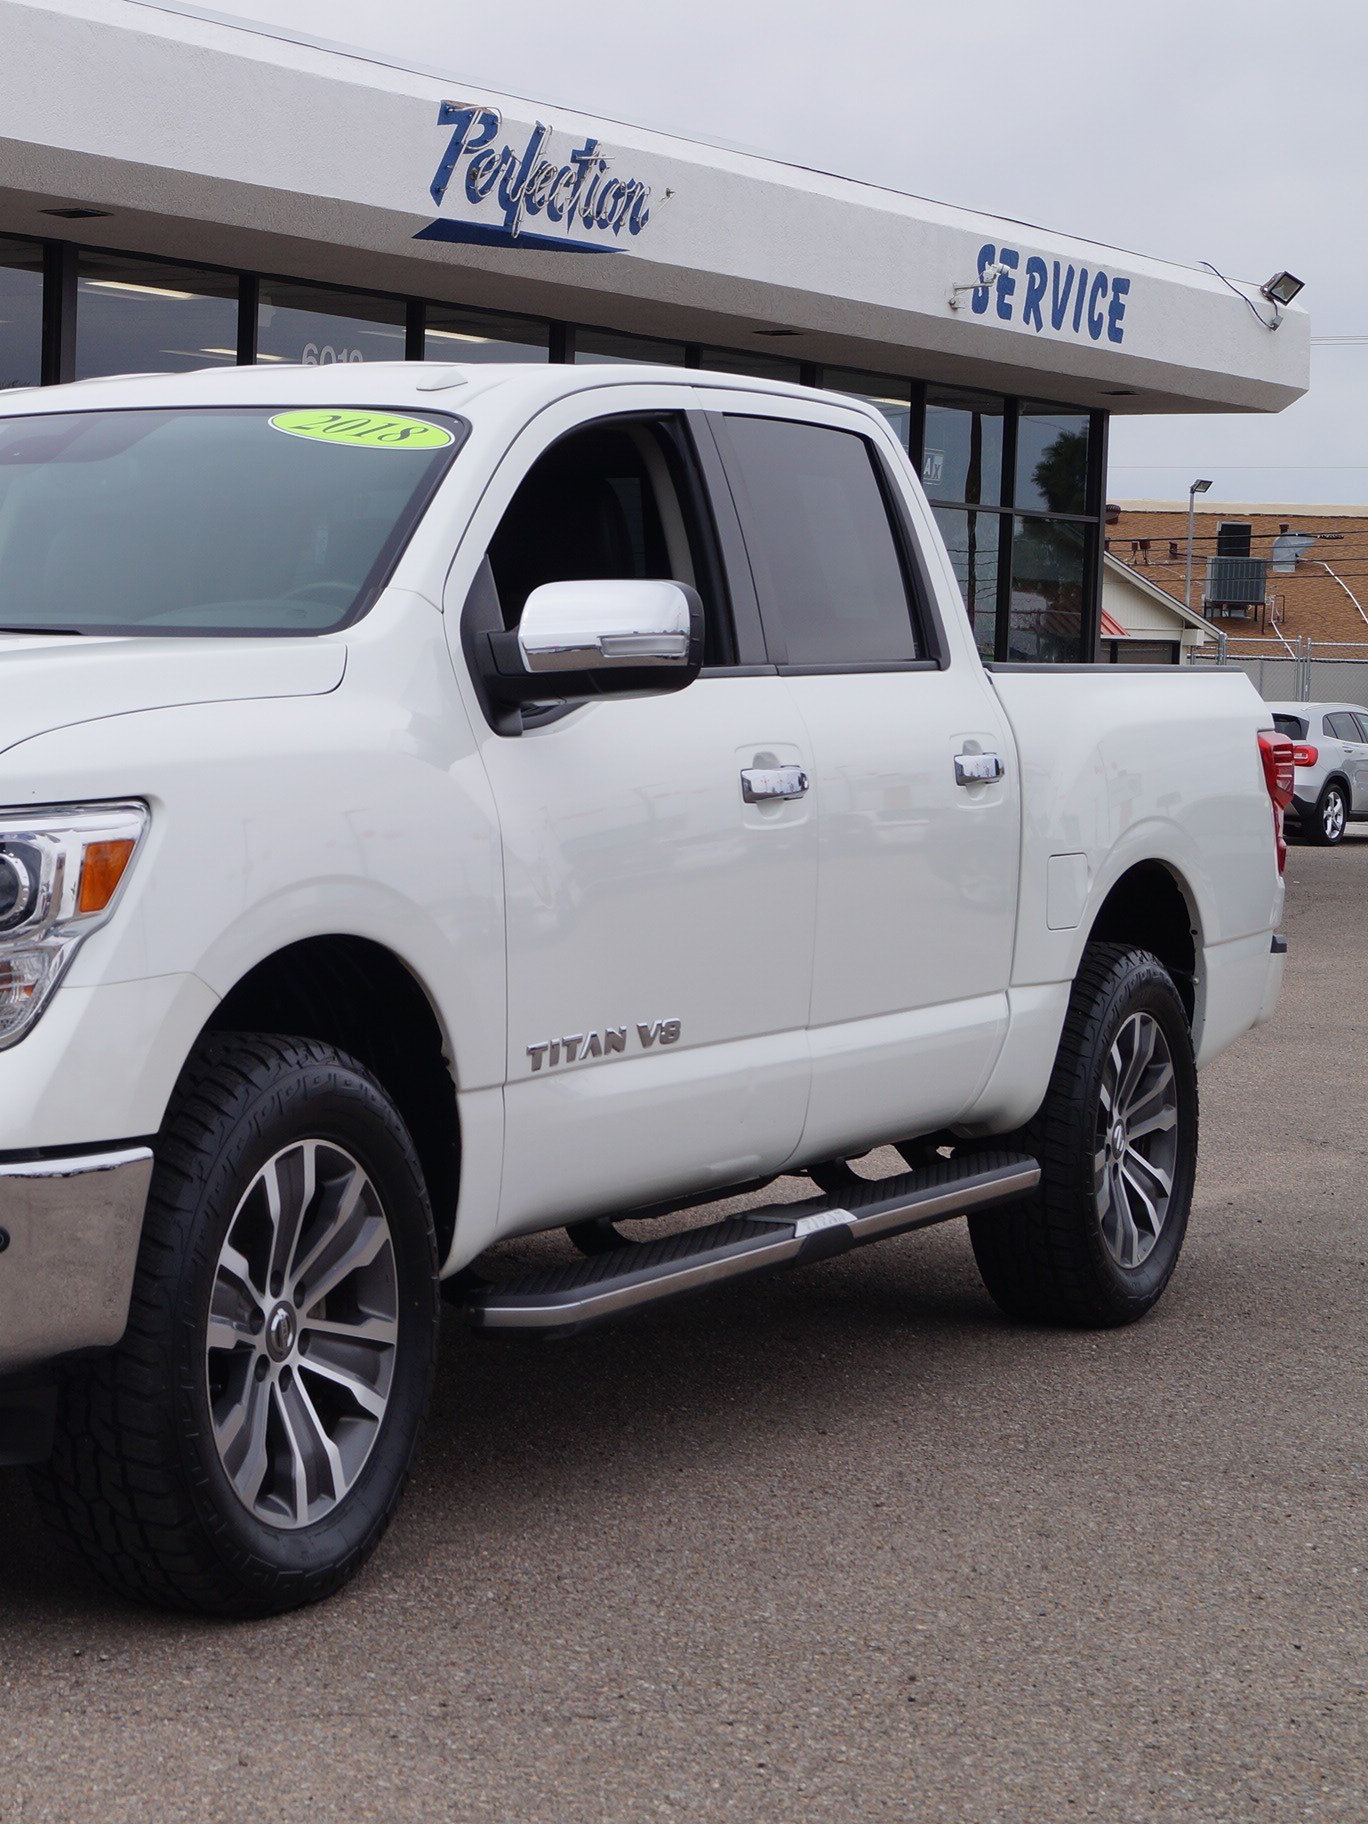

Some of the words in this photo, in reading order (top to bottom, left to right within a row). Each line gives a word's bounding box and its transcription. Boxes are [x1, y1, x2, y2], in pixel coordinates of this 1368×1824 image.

[430, 99, 652, 238] Perfection
[971, 243, 1131, 344] SERVICE
[291, 415, 429, 442] 2018
[526, 1026, 627, 1072] TITAN
[636, 1017, 681, 1049] V8
